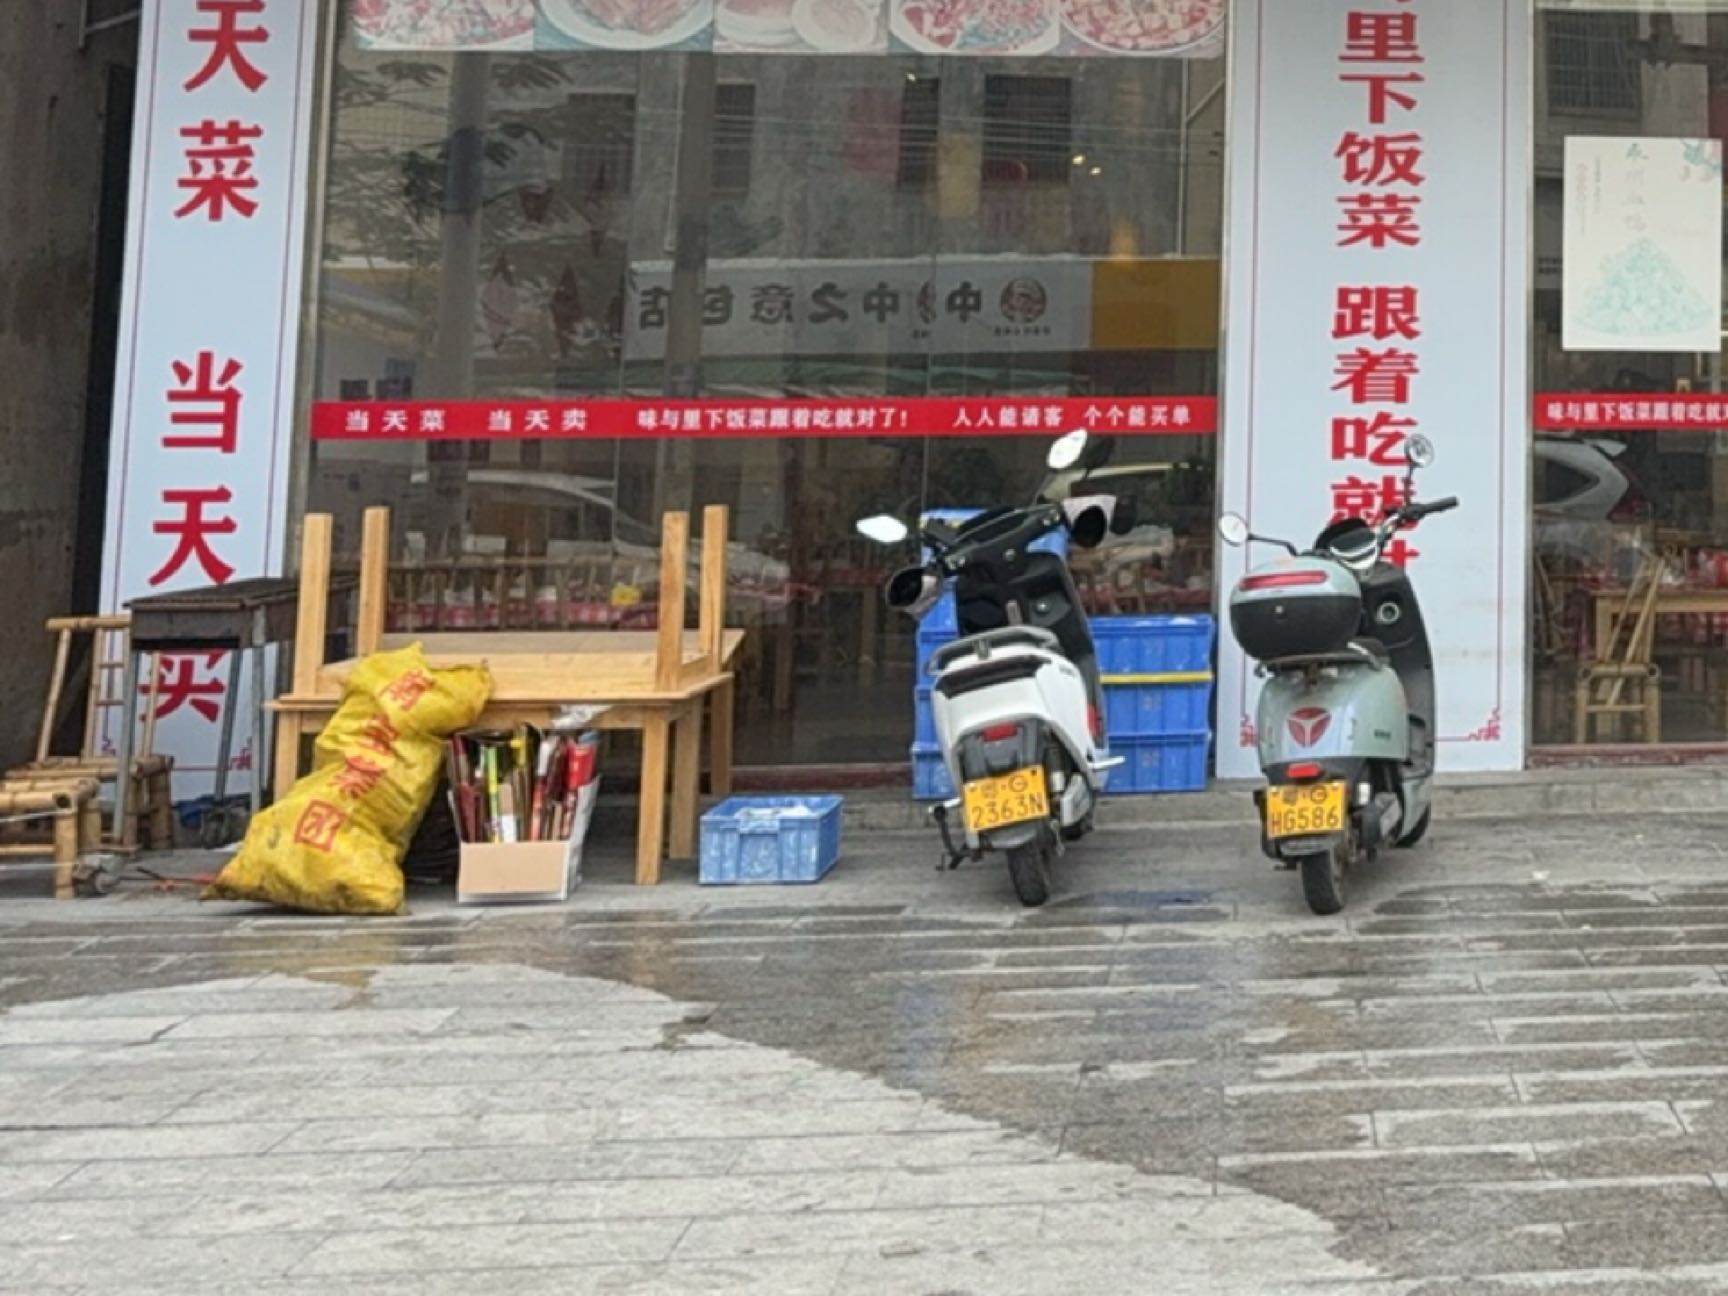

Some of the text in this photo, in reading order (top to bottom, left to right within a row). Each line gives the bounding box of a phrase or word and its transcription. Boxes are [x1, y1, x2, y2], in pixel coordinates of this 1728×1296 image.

[1330, 286, 1421, 576] 跟着吃就
[971, 793, 1044, 829] 2363N
